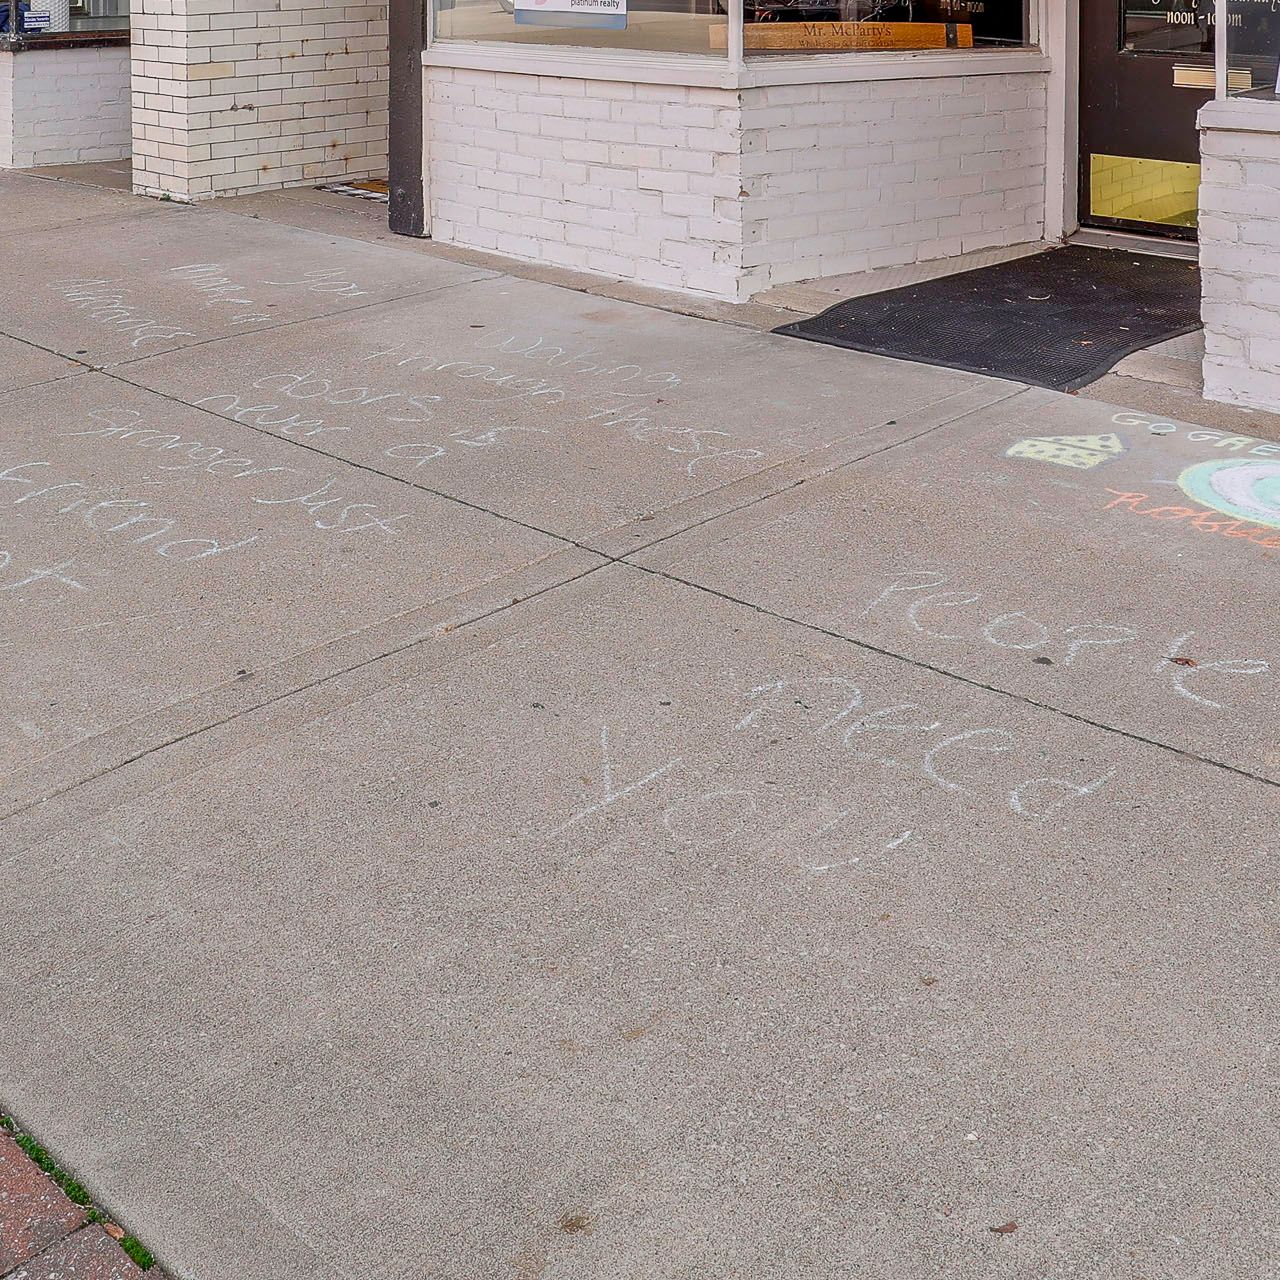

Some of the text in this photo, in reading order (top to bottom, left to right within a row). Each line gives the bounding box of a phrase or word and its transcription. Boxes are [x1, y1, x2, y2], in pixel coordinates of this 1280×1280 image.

[1166, 11, 1195, 25] noon
[803, 22, 892, 40] Mr. McParty's
[1111, 411, 1179, 435] GO
